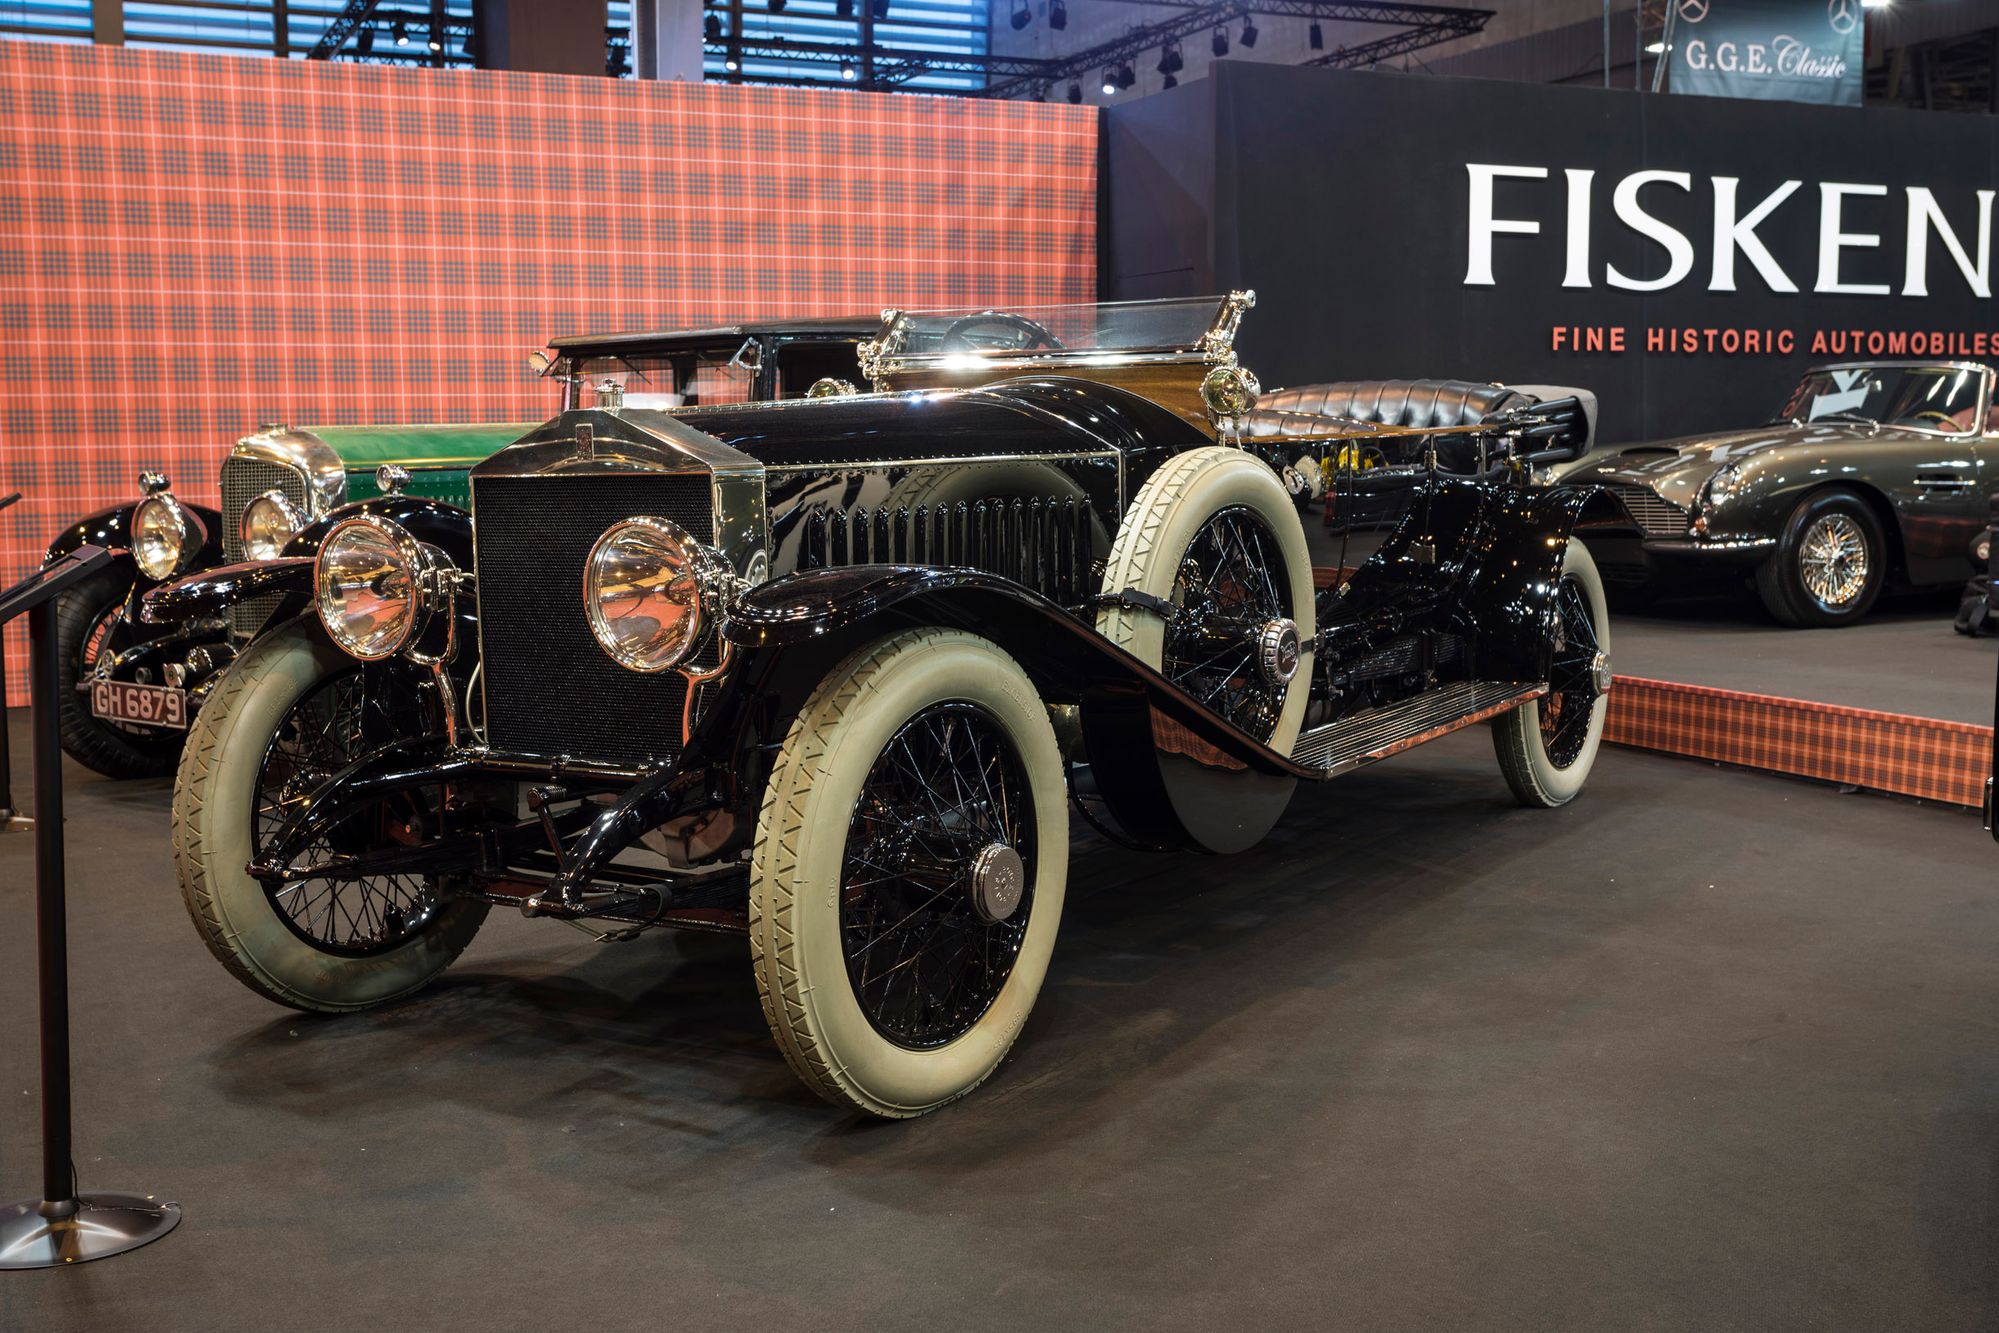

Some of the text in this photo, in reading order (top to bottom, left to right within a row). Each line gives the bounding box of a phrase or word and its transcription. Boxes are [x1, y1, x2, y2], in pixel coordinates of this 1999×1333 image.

[1686, 34, 1847, 79] G.G.E. Classic
[1463, 163, 1996, 298] FISKEN
[1552, 326, 1999, 356] FINE HISTORIC AUTOMOBILES
[96, 684, 180, 722] GH 6879
